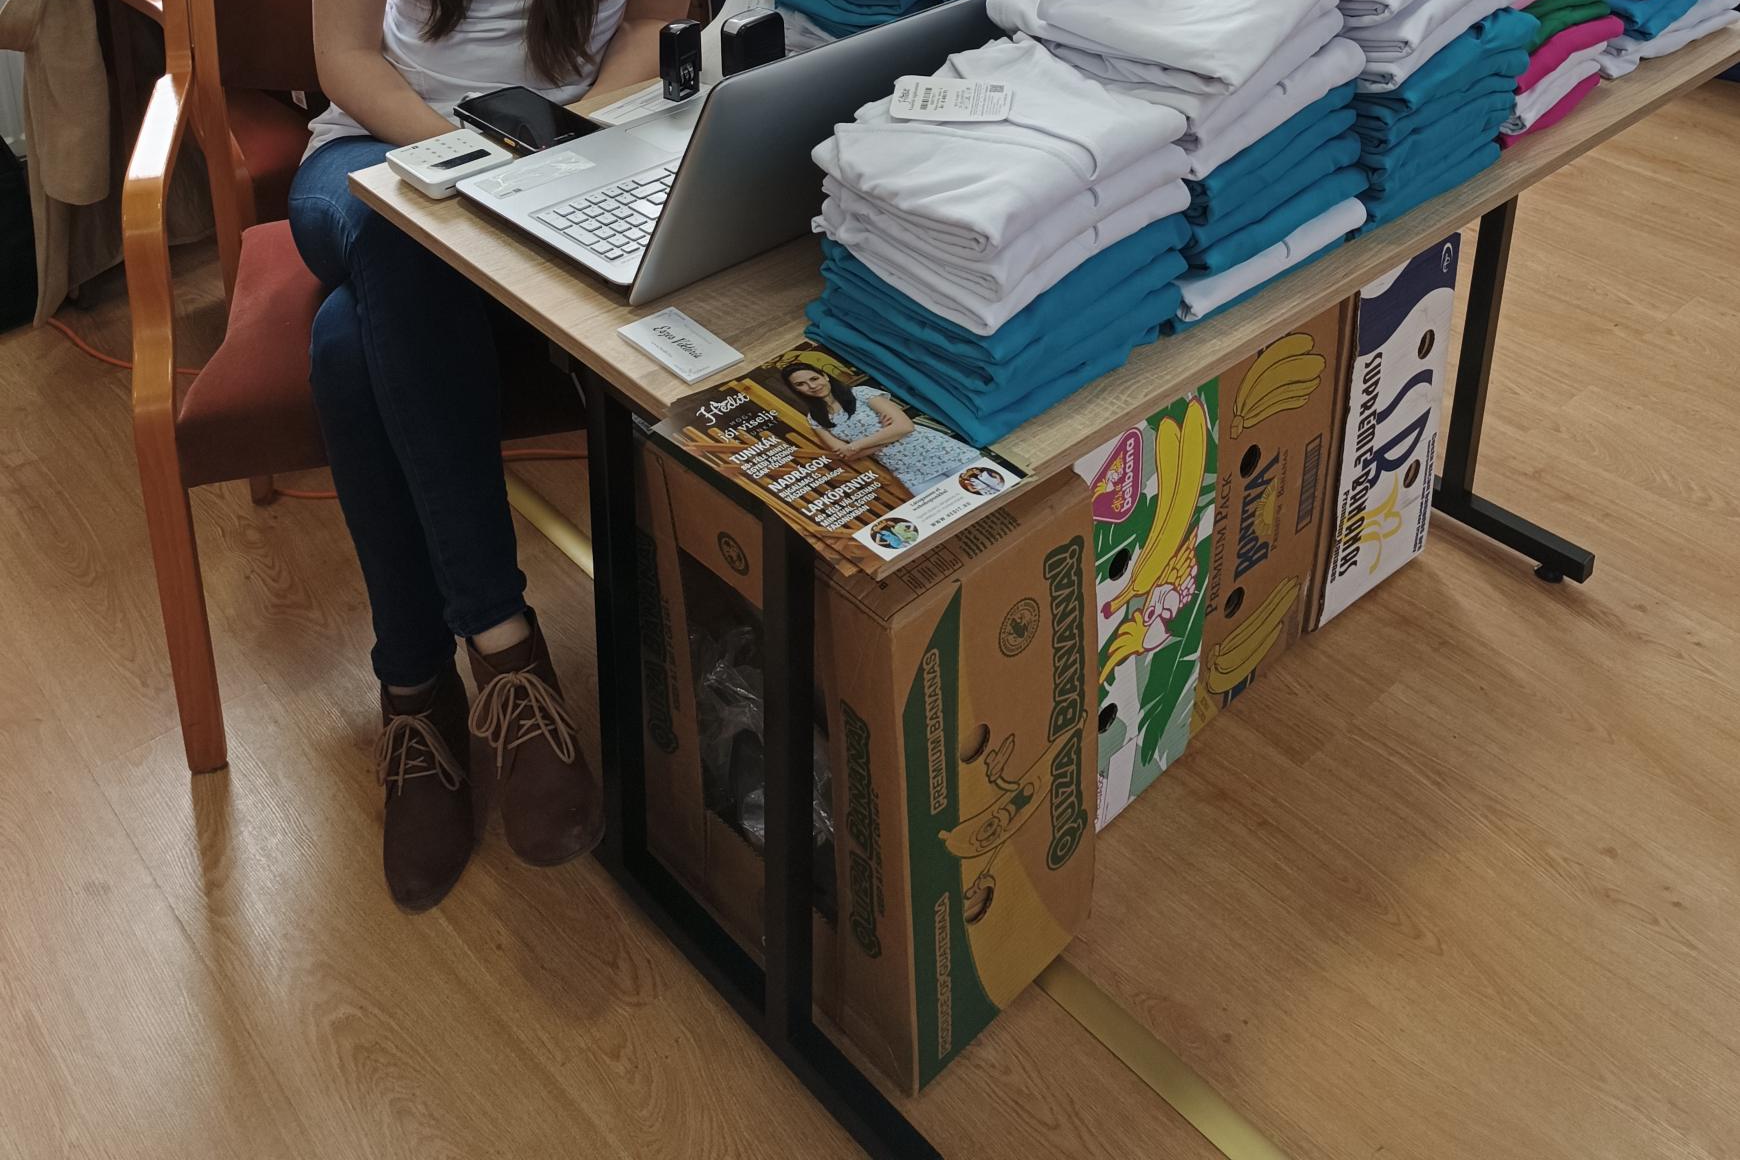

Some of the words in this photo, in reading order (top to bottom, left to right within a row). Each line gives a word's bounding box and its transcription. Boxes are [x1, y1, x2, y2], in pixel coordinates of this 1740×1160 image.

[696, 392, 750, 426] Hedit
[737, 409, 778, 431] viselje
[1353, 351, 1384, 468] SUPREME
[729, 435, 780, 464] TUNIKÁK
[746, 461, 770, 475] EGYEDI
[769, 445, 799, 463] FAZONOK
[766, 443, 789, 457] MINTA
[753, 469, 770, 479] CSAK
[768, 455, 833, 493] NADRÁGOK
[778, 476, 812, 499] RUGALMAS
[810, 467, 846, 490] NADRÁGOK
[840, 481, 881, 507] VÁLASZTHATÓ
[1120, 437, 1135, 513] belbana
[855, 492, 878, 508] EGYEDI
[1215, 471, 1233, 526] PACK
[1233, 446, 1281, 584] BONITA
[1338, 466, 1372, 578] BANANAS
[1205, 525, 1227, 618] PREMIUM
[1043, 534, 1086, 743] BANANA!
[922, 648, 945, 735] BANANAS
[929, 733, 947, 816] PREMIUM
[1046, 727, 1086, 872] QUIZA
[934, 892, 951, 976] GUATEMALA
[937, 974, 951, 998] OF
[937, 996, 953, 1059] PRODUCE
